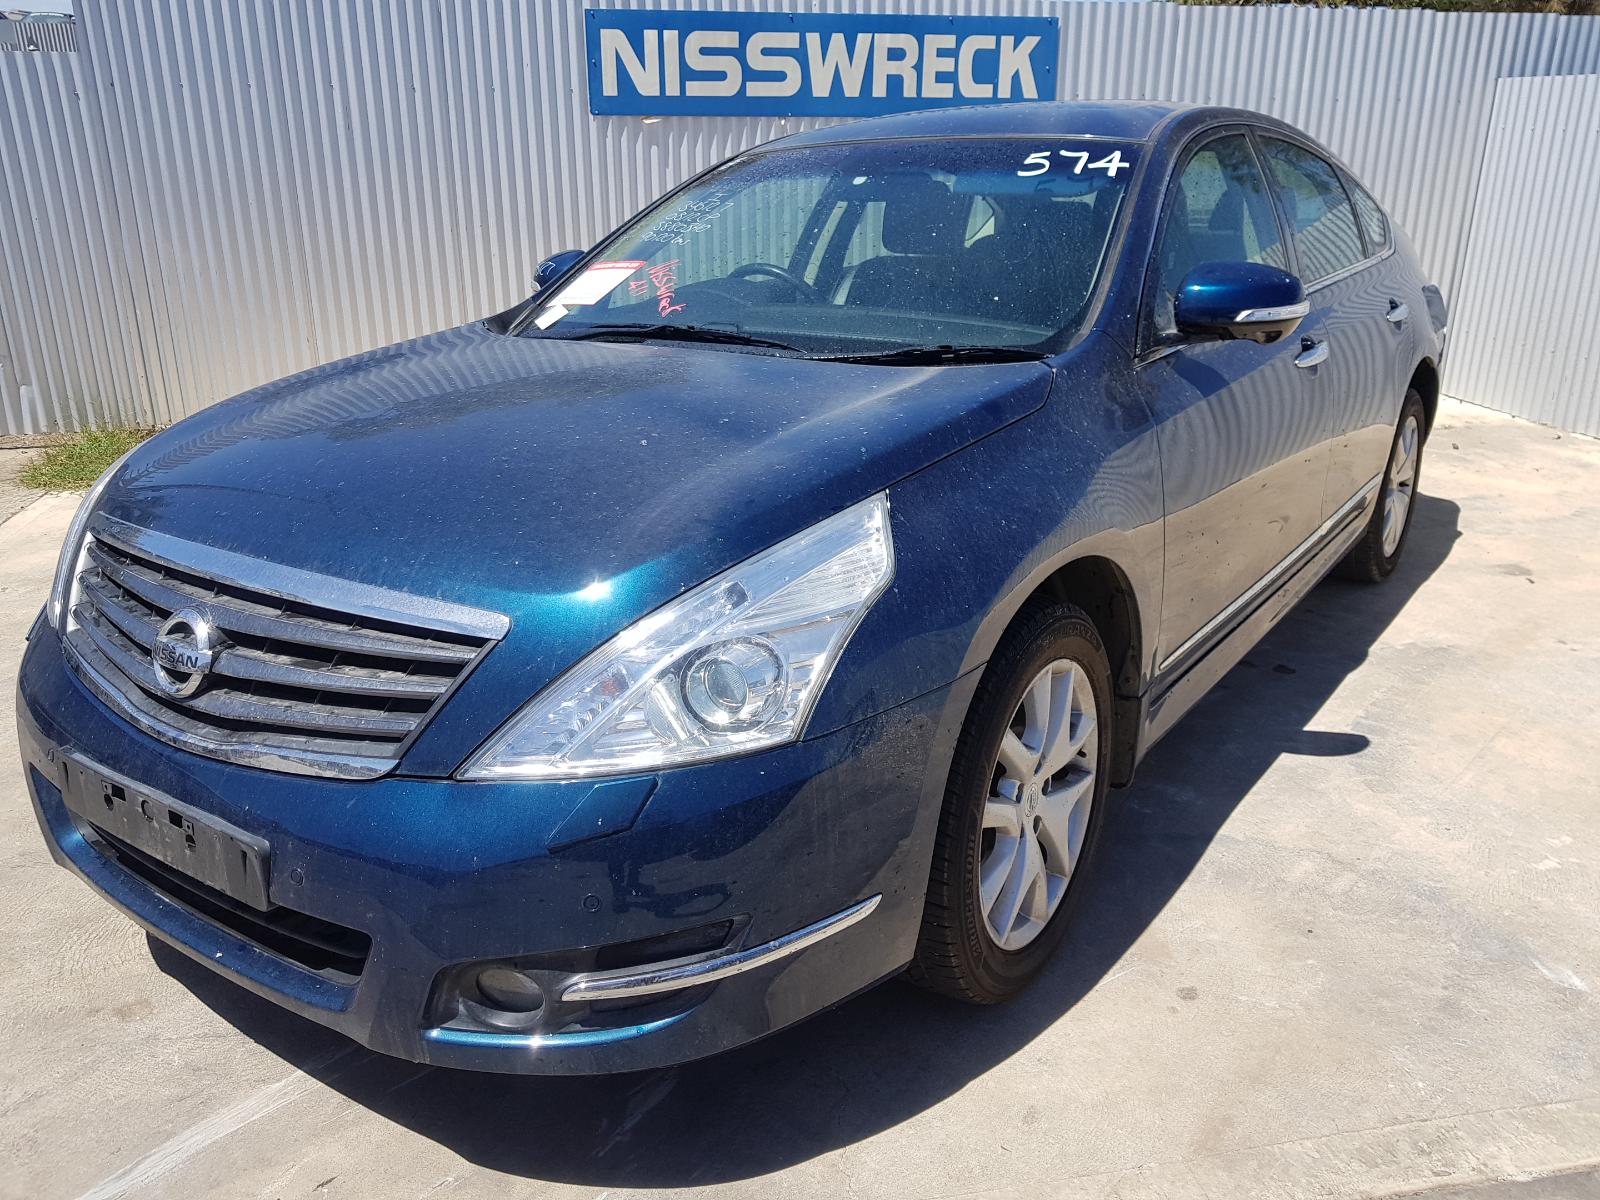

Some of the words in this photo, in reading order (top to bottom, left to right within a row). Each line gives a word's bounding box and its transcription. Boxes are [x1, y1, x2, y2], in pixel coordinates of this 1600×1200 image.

[599, 28, 1041, 100] NISSWRECK
[1016, 149, 1130, 177] 574
[154, 644, 199, 670] NISSAN
